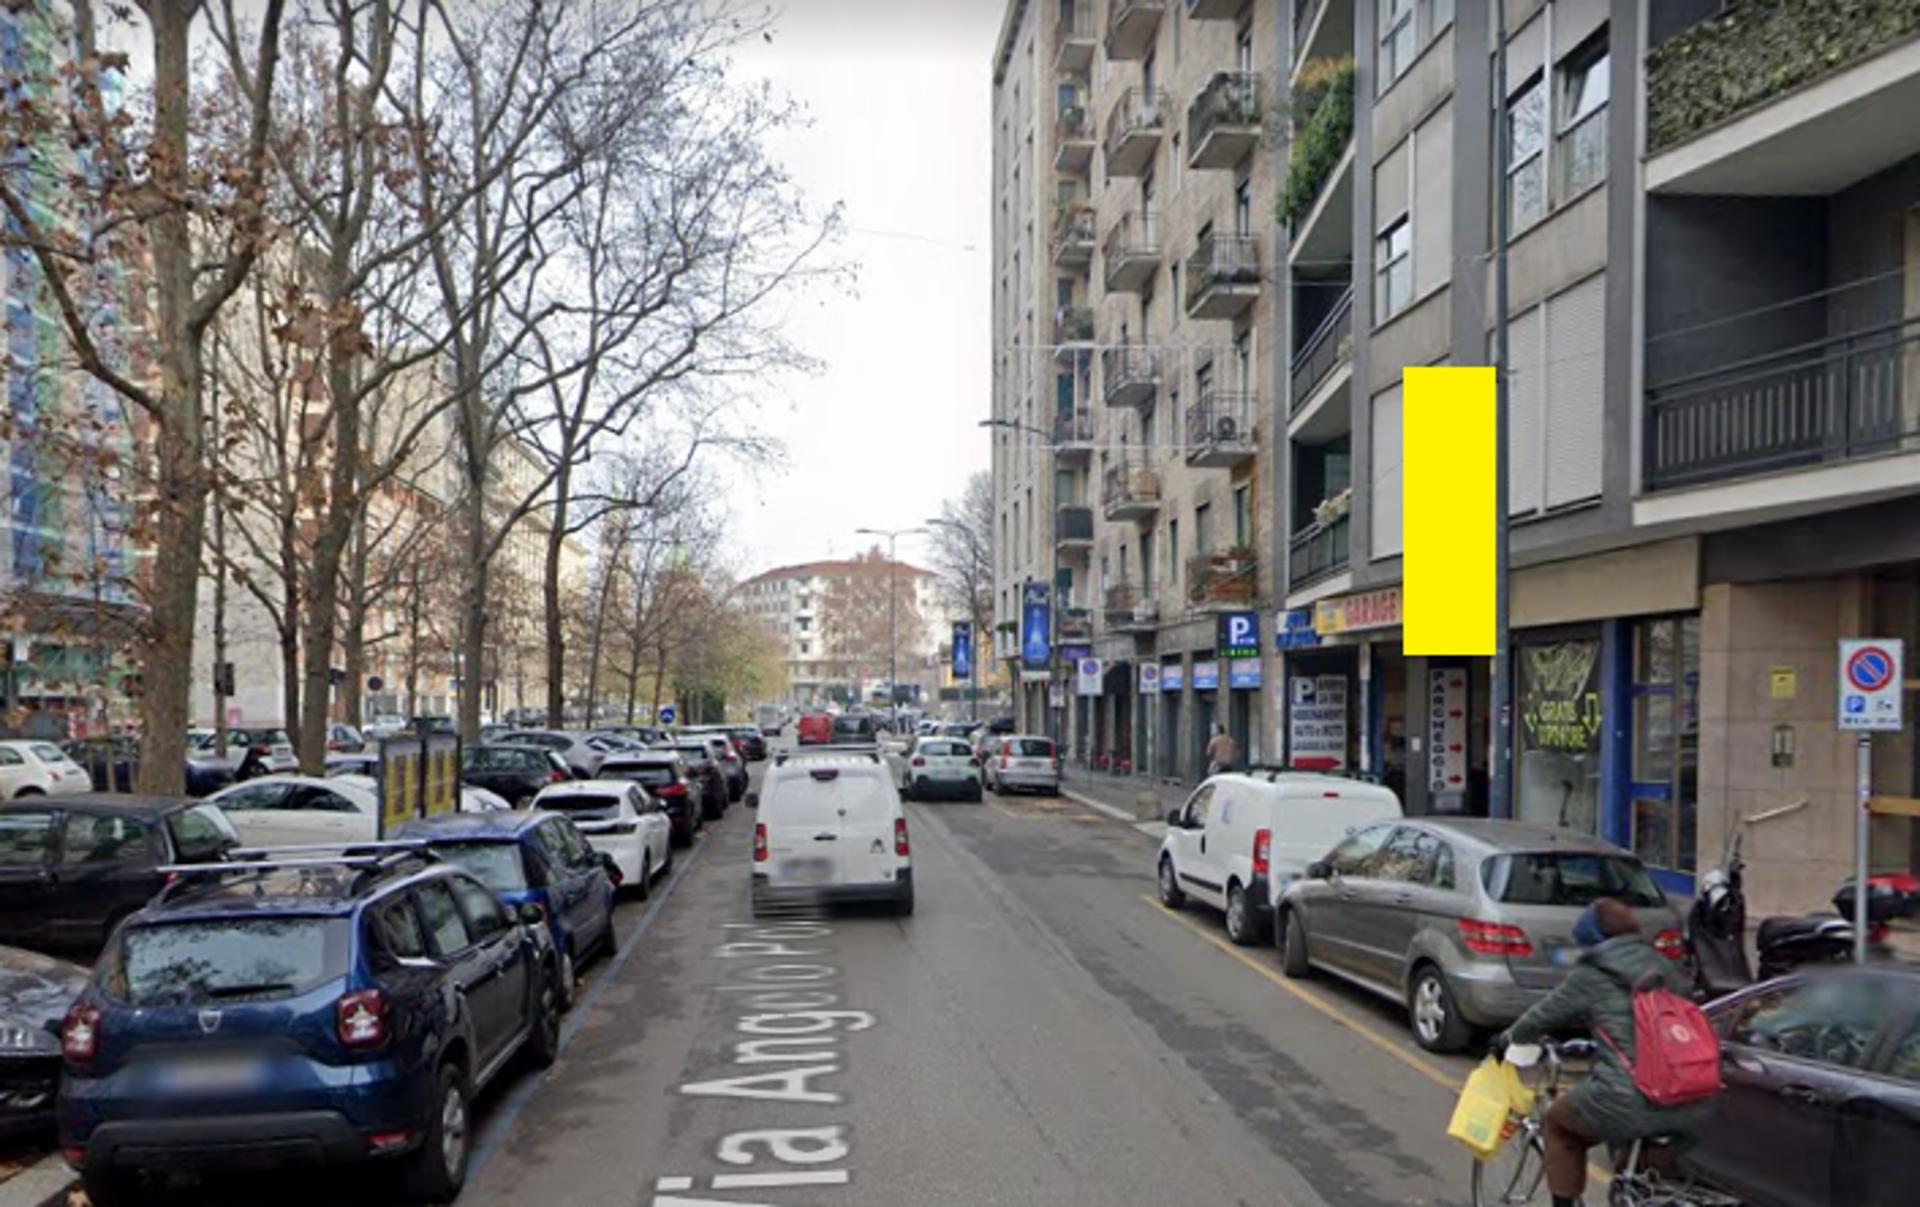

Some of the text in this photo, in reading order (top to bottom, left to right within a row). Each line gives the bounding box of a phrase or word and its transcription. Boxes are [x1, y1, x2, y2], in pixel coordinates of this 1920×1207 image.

[1344, 591, 1396, 627] GARAGE
[1231, 616, 1250, 646] P
[1294, 678, 1315, 703] P
[1432, 670, 1446, 792] PARCHEGGIO
